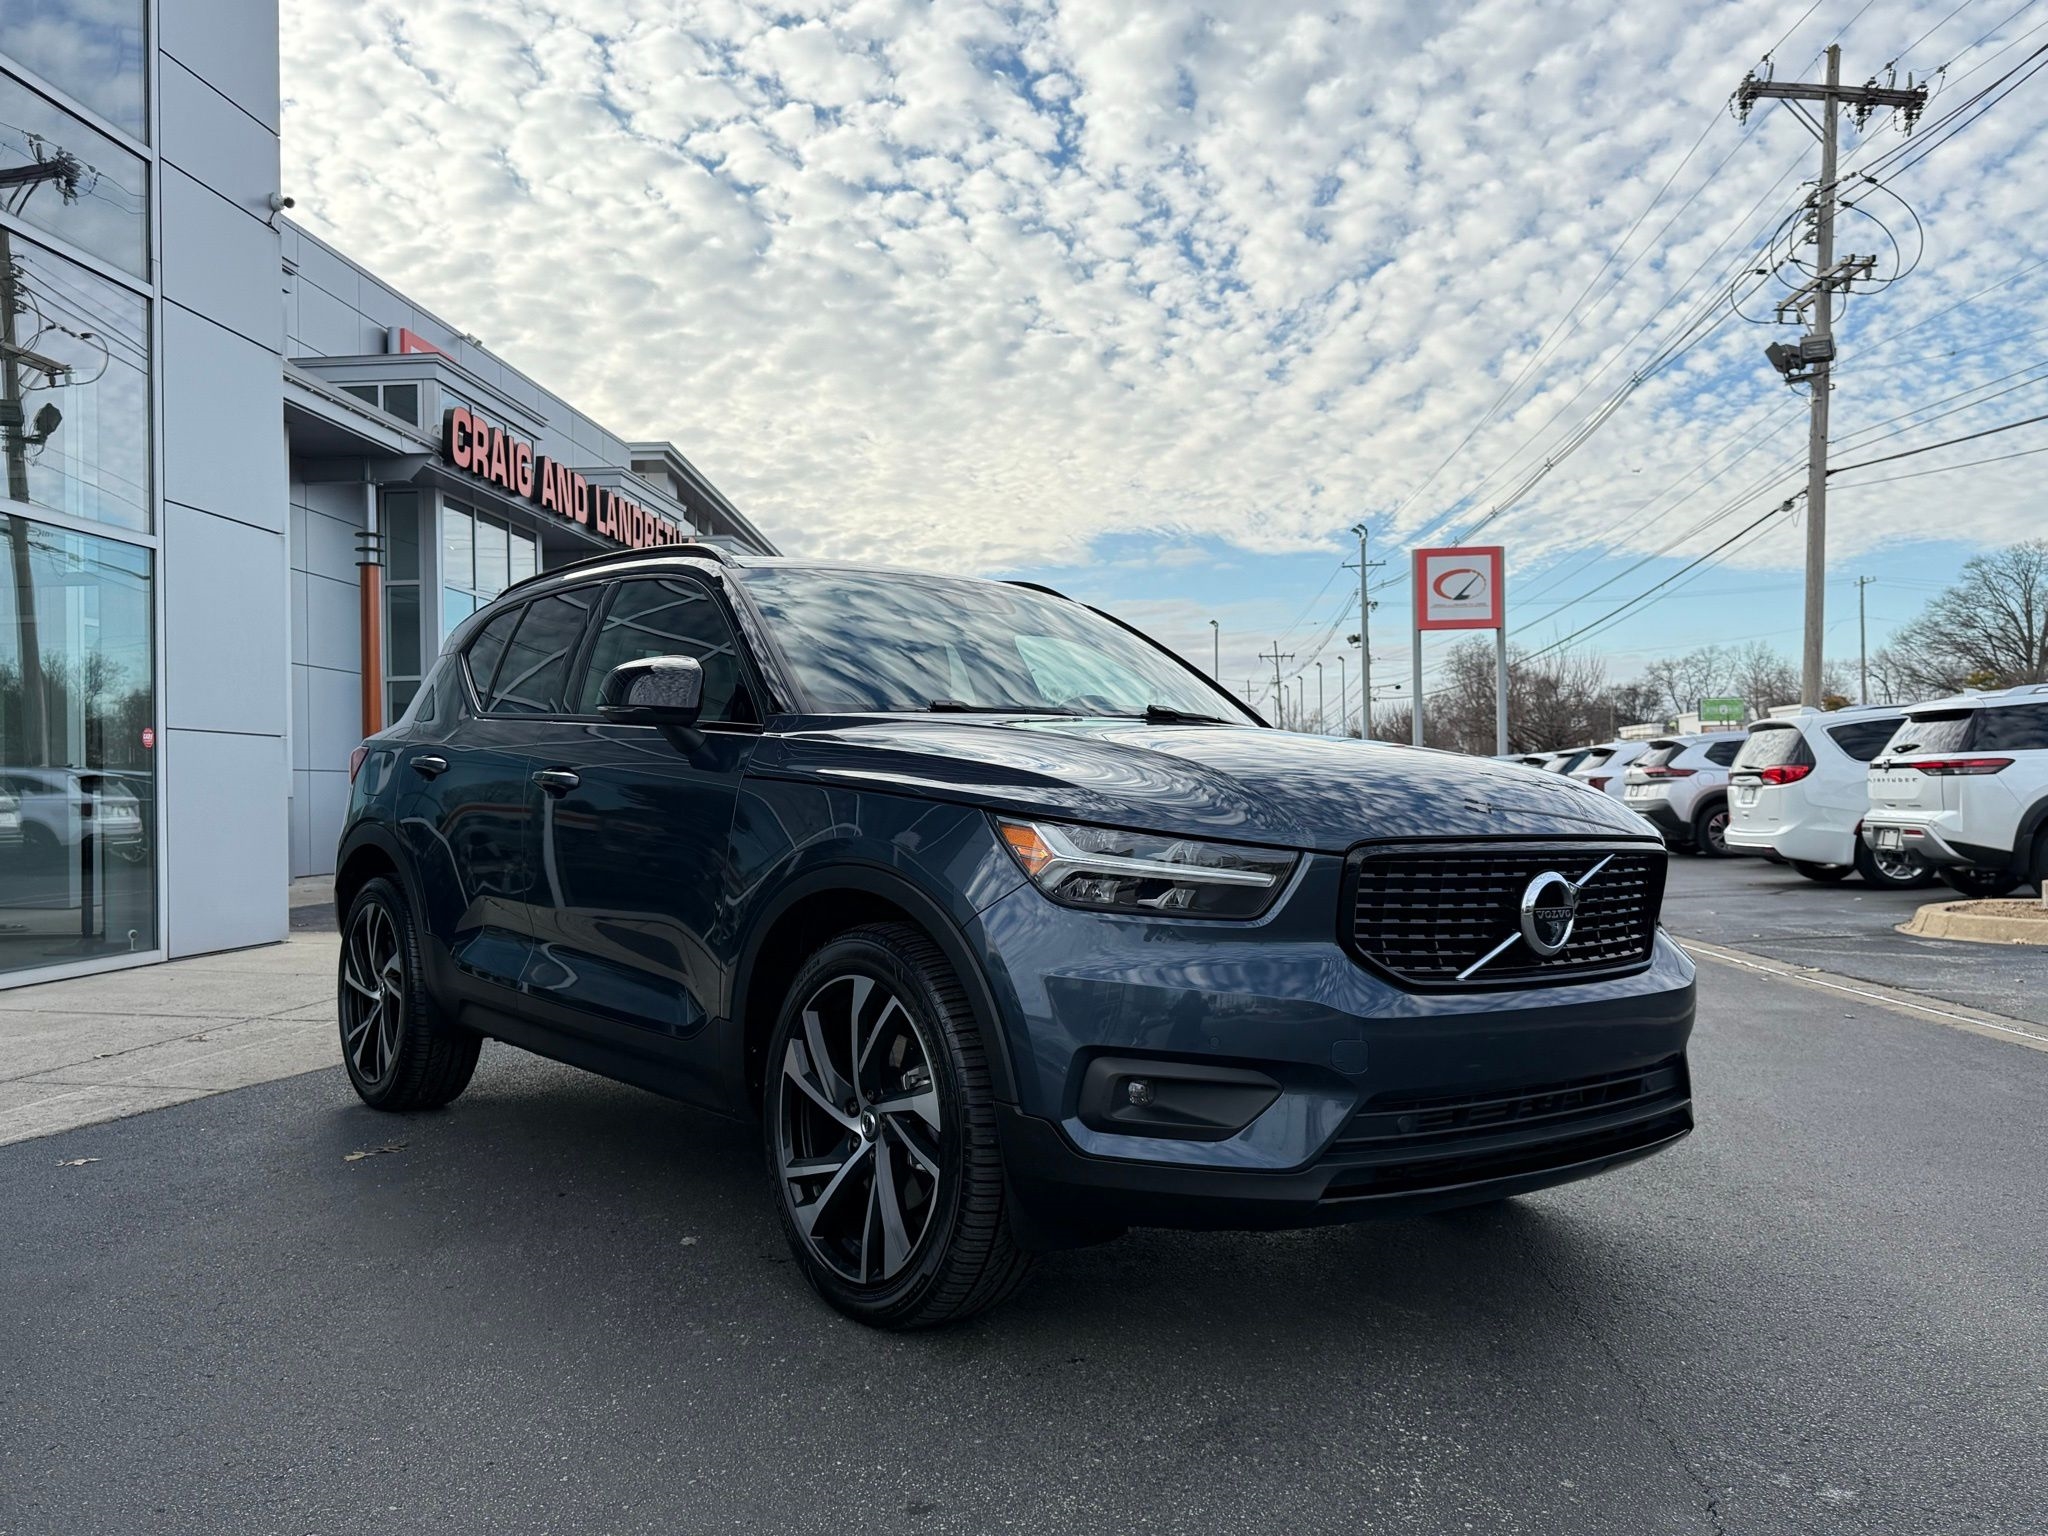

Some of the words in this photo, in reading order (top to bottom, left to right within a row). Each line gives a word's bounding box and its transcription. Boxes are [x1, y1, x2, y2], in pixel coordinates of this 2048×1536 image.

[451, 406, 534, 498] CRAIG
[541, 456, 588, 525] AND
[1535, 908, 1571, 920] VOLVO
